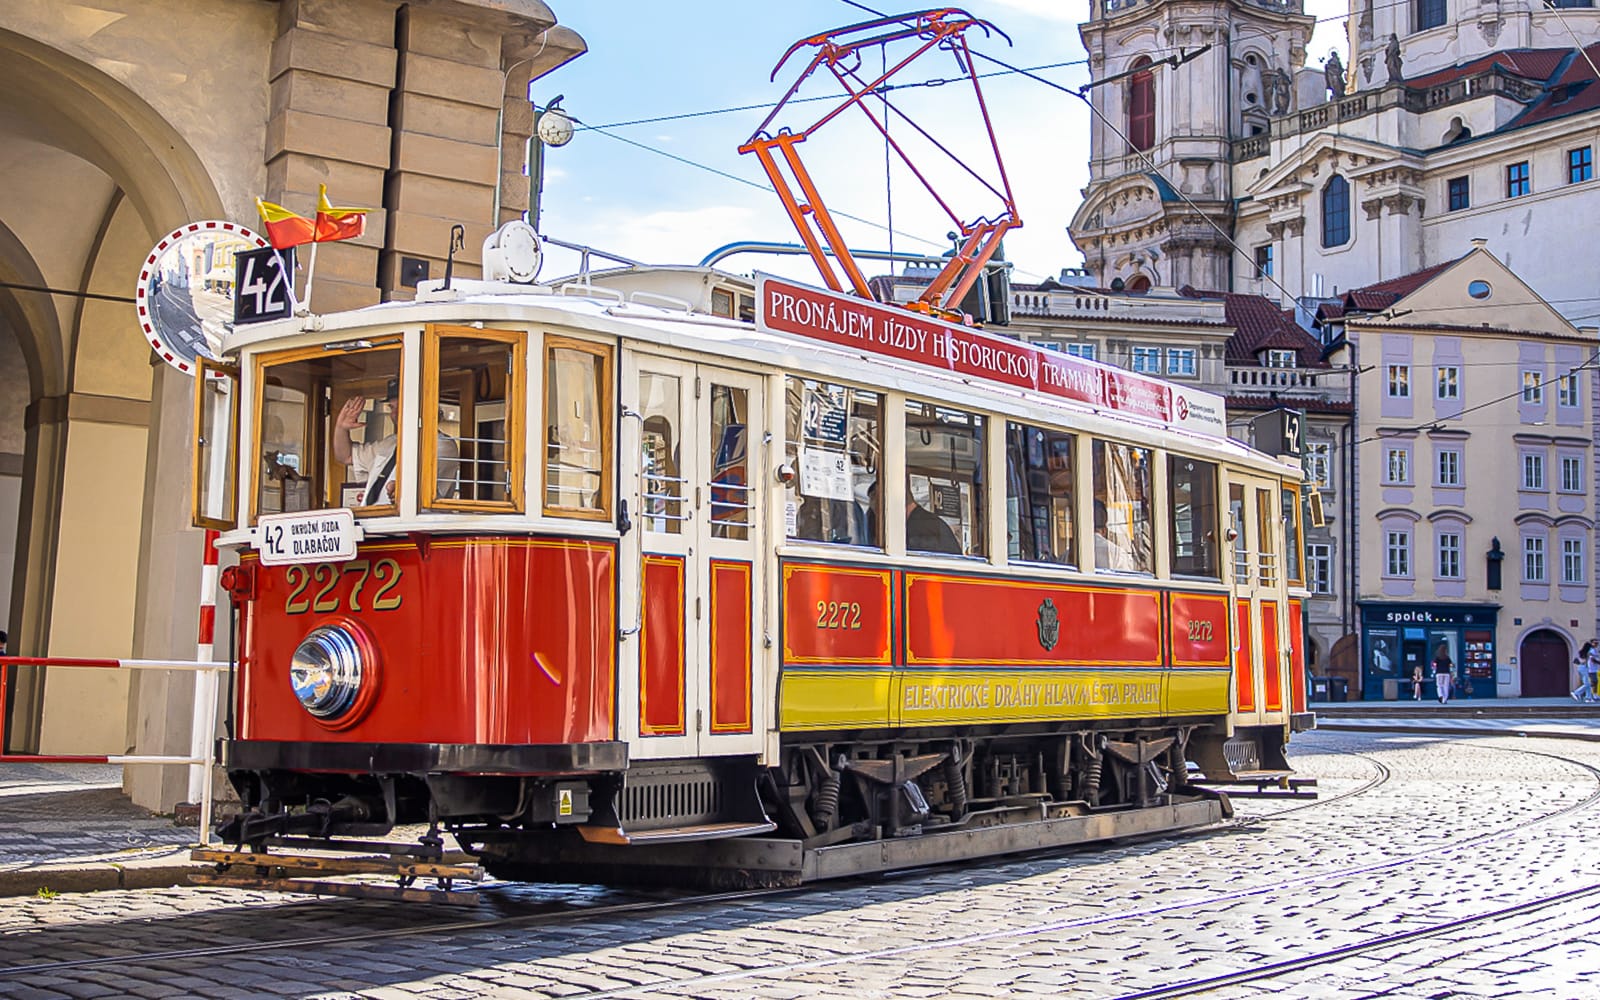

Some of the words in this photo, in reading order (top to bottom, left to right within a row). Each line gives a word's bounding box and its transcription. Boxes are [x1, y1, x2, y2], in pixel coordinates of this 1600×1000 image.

[241, 256, 285, 314] 42
[771, 291, 873, 341] PRONÁJEM
[879, 317, 928, 353] JÍZDY
[932, 332, 1039, 381] HISTORICKOU
[1285, 414, 1300, 453] 42
[265, 525, 285, 555] 42
[293, 535, 340, 555] DLABAČOV
[285, 558, 403, 615] 2272
[816, 600, 862, 630] 2272
[1188, 619, 1213, 641] 2272
[904, 679, 989, 711] ELEKTRICKÉ
[994, 678, 1042, 708] DRÁHY
[1078, 680, 1120, 705] MĚSTA
